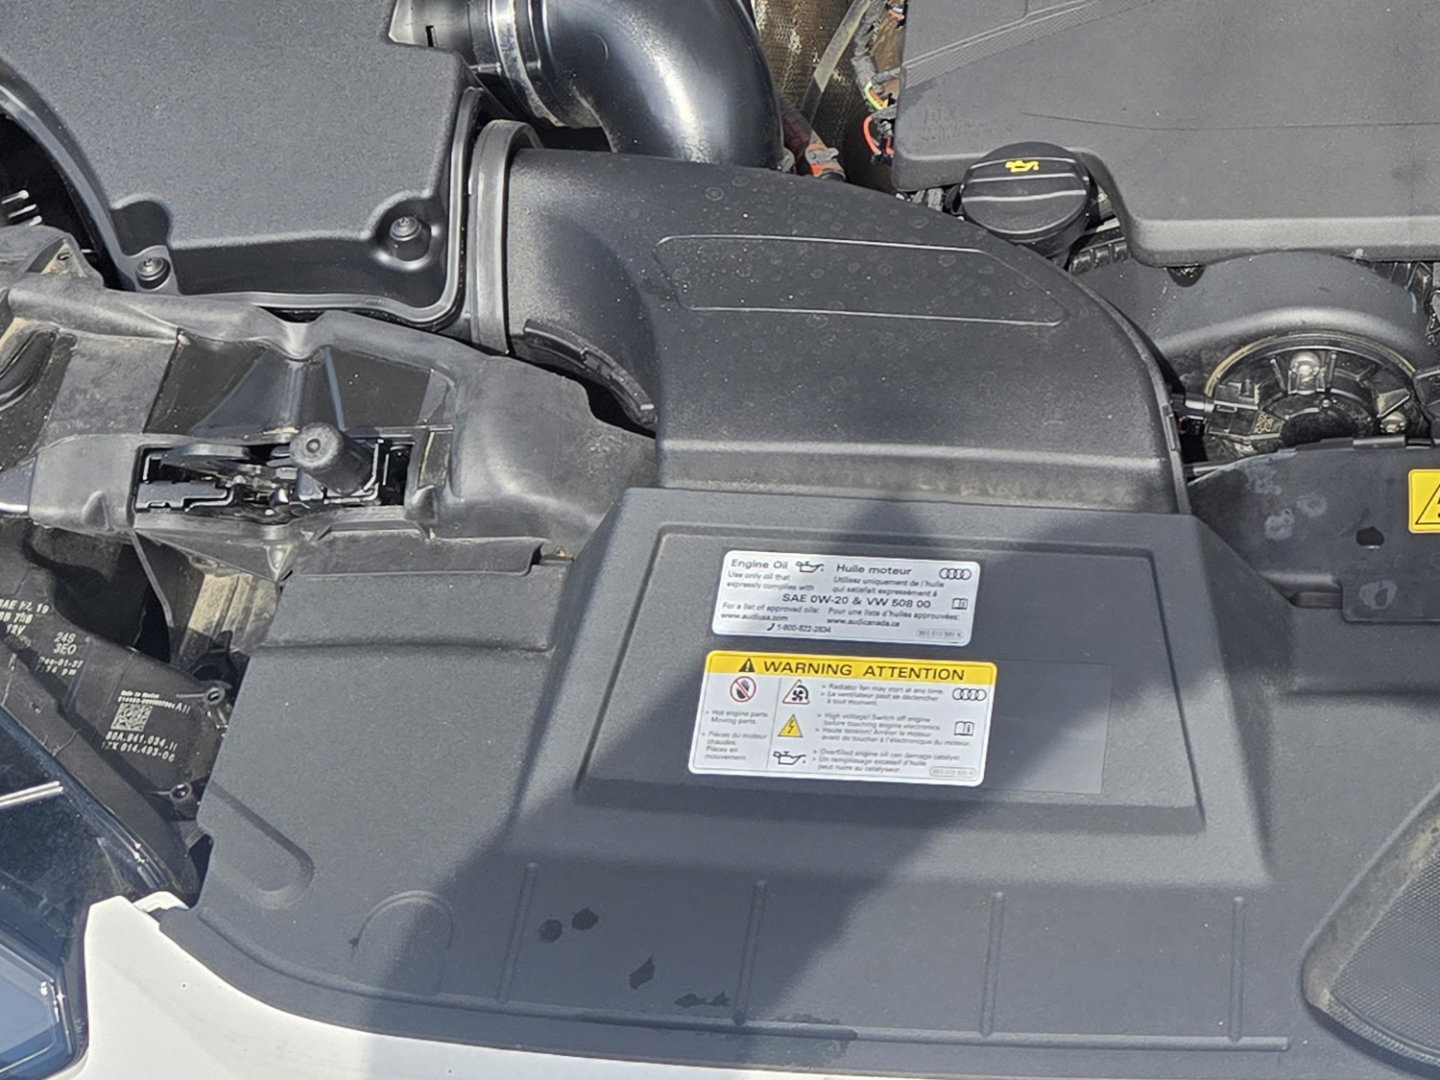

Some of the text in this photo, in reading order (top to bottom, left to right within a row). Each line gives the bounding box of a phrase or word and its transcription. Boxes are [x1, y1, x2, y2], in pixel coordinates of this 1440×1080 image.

[731, 559, 788, 570] Engine Oil
[836, 564, 912, 575] Huile moteur
[782, 593, 931, 608] SAE 0W-20 & VW 508 00
[764, 661, 965, 680] WARNING ATTENTION
